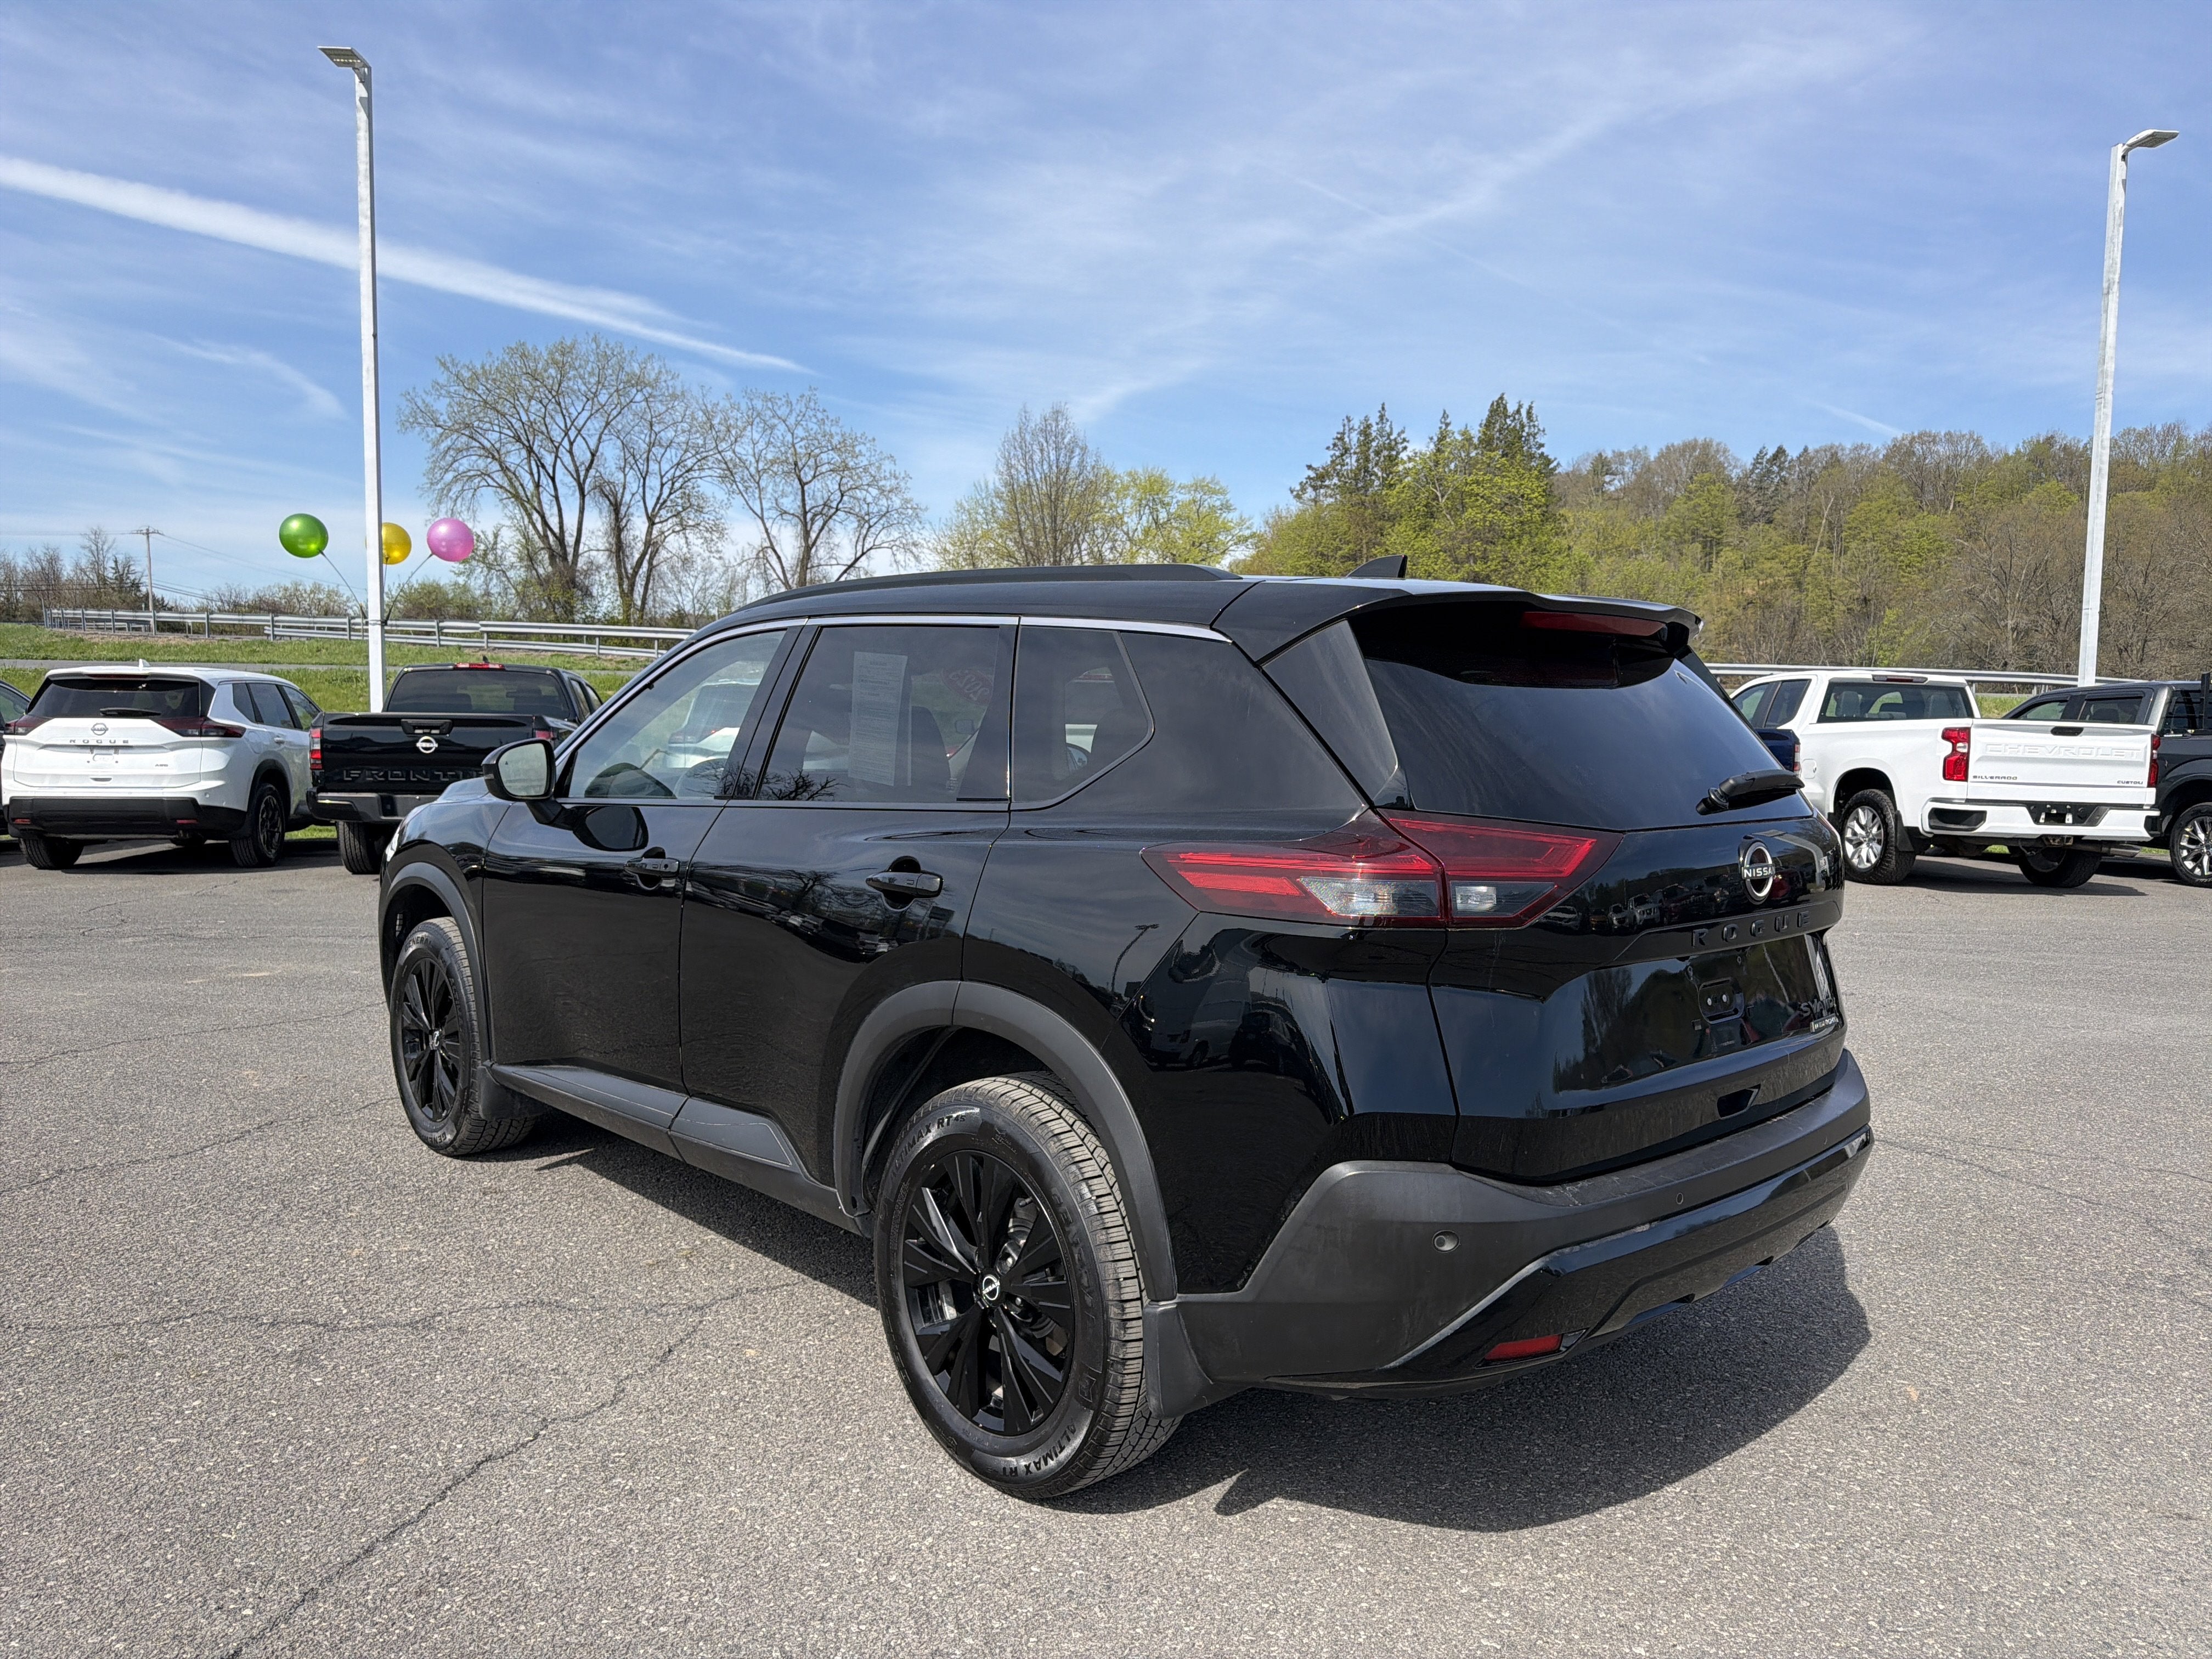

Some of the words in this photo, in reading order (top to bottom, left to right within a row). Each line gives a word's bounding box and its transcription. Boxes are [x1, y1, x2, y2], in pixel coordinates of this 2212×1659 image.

[1985, 743, 2142, 759] CHEVROLET
[1691, 910, 1809, 948] ROGUE
[1024, 1421, 1076, 1476] ALTIMAX
